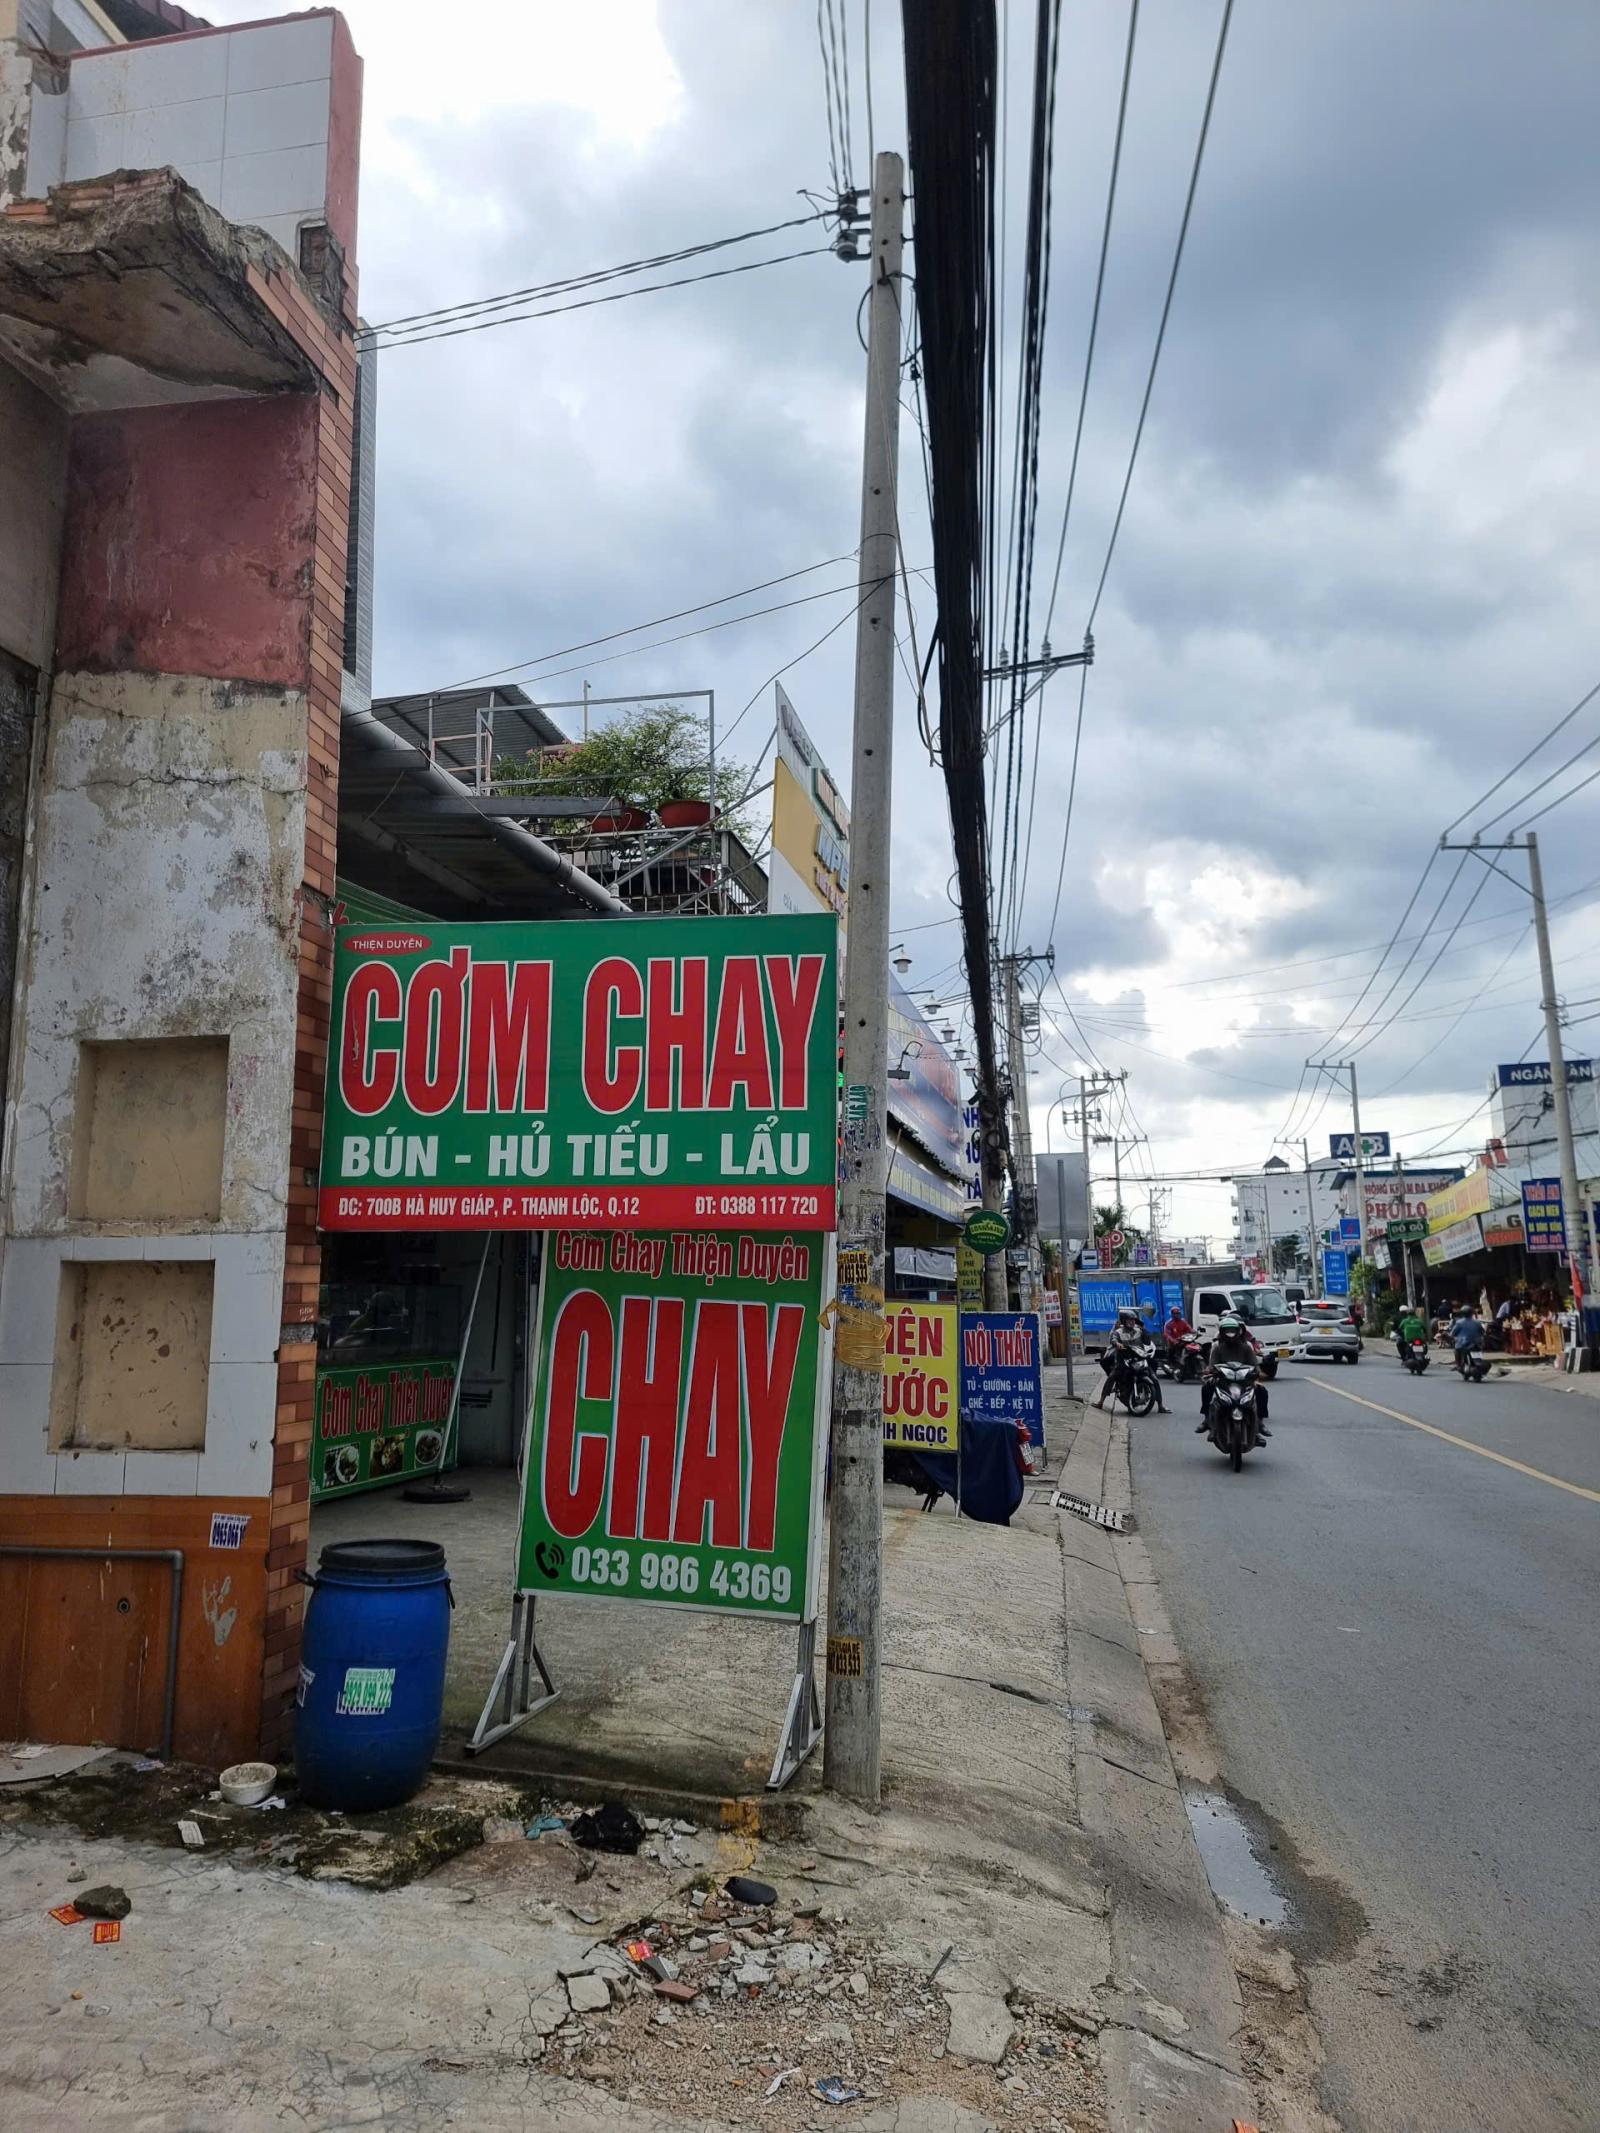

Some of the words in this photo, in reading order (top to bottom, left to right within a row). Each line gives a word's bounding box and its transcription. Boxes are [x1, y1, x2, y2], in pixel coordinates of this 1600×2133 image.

[353, 940, 384, 951] THIỆN
[387, 938, 423, 950] DUYÊN
[339, 945, 554, 1116] CƠM
[583, 953, 827, 1116] CHAY
[341, 1126, 440, 1178] BÚN
[488, 1120, 551, 1177] HỦ
[567, 1120, 670, 1176] TIẾU
[720, 1115, 811, 1175] LẨU
[1337, 1136, 1385, 1155] AB
[338, 1198, 363, 1217] ĐC:
[366, 1197, 402, 1217] 700B
[406, 1194, 426, 1216] HÀ
[429, 1198, 458, 1216] HUY
[461, 1194, 498, 1219] GIÁP,
[503, 1198, 517, 1217] P.
[521, 1198, 568, 1219] THẠNH
[571, 1193, 604, 1221] LỘC,
[607, 1197, 640, 1218] Q.12
[695, 1196, 717, 1215] ĐT:
[720, 1196, 755, 1215] 0388
[758, 1196, 784, 1215] 117
[787, 1196, 818, 1215] 720
[555, 1230, 606, 1271] Cơm
[610, 1233, 665, 1280] Chay
[671, 1233, 733, 1285] Thiện
[738, 1237, 810, 1286] Duyên
[885, 1307, 944, 1365] IỆN
[964, 1321, 992, 1376] NỘI
[994, 1317, 1033, 1368] THẤT
[321, 1377, 353, 1440] Cơm
[354, 1373, 386, 1437] Chay
[389, 1368, 421, 1438] Thiện
[883, 1368, 949, 1420] ƯỚC
[967, 1376, 976, 1392] TỦ
[983, 1376, 1012, 1392] GIƯỜNG
[1018, 1377, 1035, 1393] BÀN
[969, 1395, 983, 1409] GHẾ
[991, 1395, 1006, 1410] BẾP
[1013, 1396, 1024, 1411] KỆ
[1025, 1398, 1034, 1410] TV
[541, 1287, 806, 1554] CHAY
[902, 1423, 948, 1447] NGỌC
[571, 1546, 630, 1588] 033
[640, 1554, 699, 1594] 986
[709, 1559, 792, 1604] 4369
